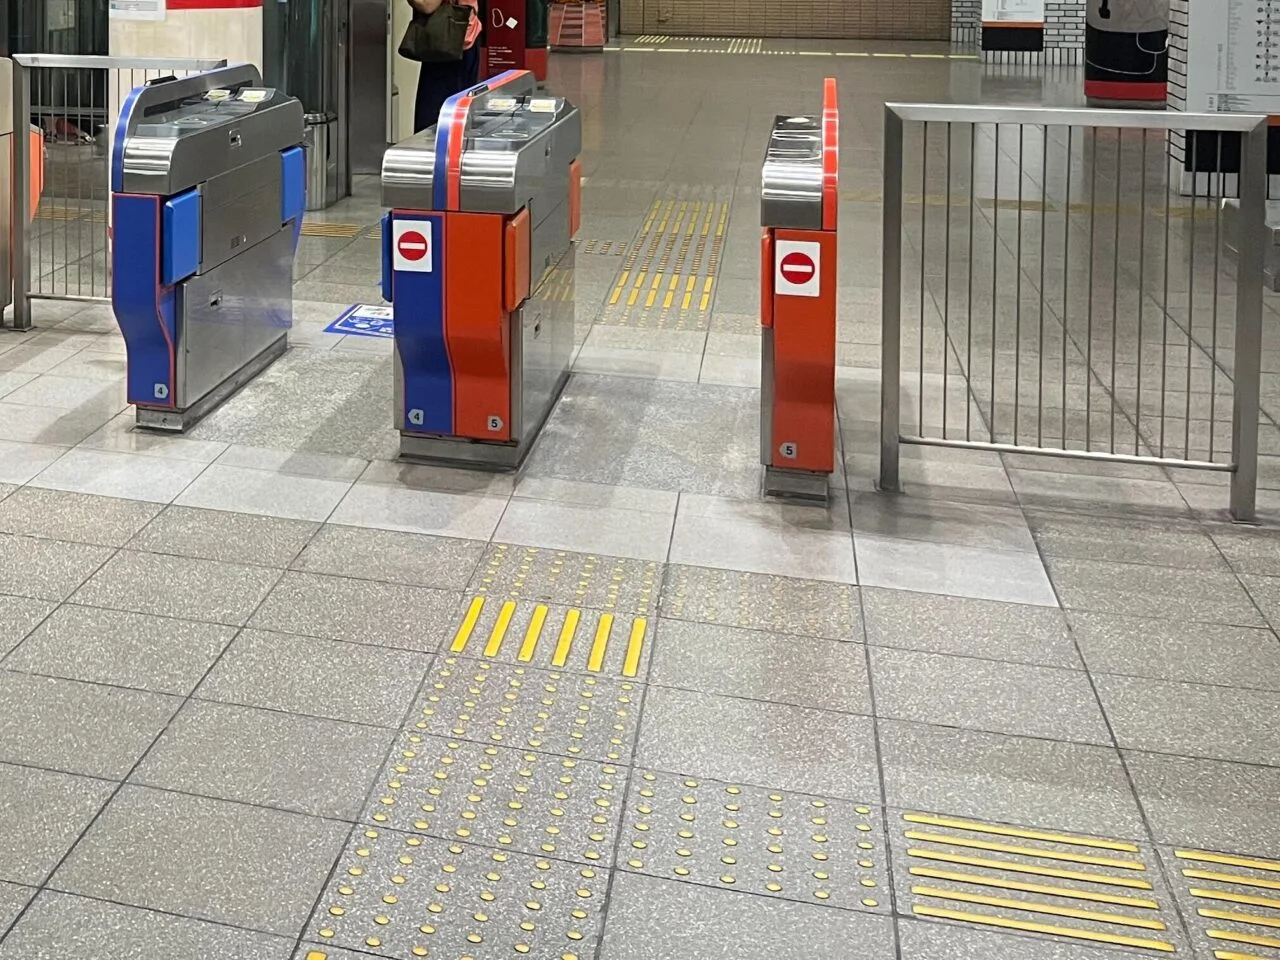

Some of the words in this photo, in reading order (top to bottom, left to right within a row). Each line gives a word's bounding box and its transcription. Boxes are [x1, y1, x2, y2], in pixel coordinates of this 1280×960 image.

[158, 387, 163, 395] 4
[414, 413, 420, 421] 4
[491, 419, 498, 428] 5
[786, 446, 793, 455] 5
